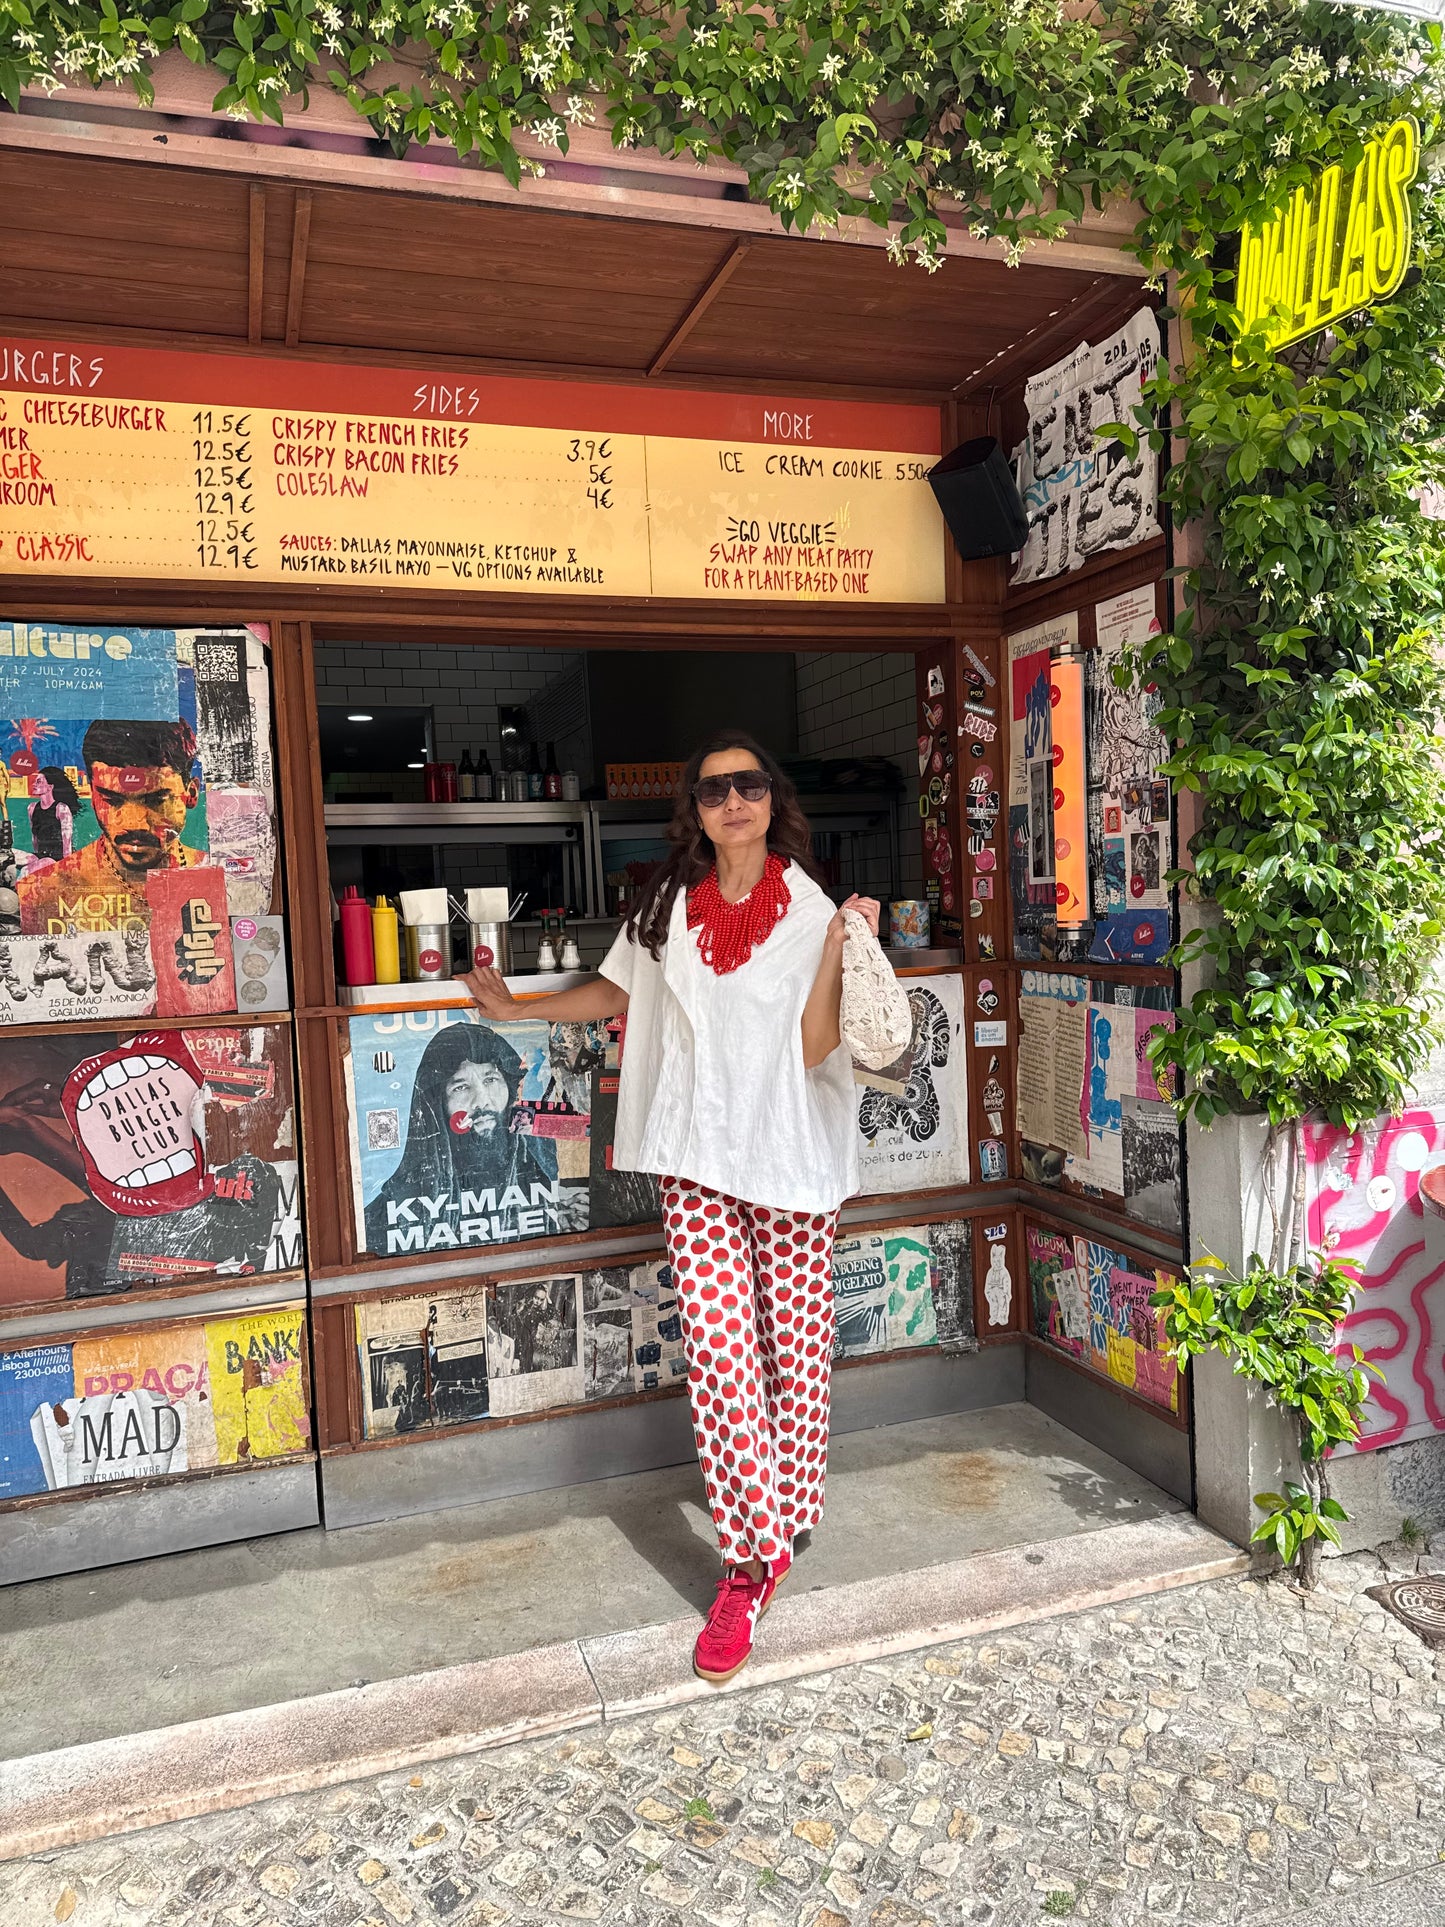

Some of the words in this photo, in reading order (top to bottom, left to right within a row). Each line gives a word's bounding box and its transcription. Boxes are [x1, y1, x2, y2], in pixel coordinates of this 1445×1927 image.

[413, 384, 480, 416] SIDES
[24, 399, 167, 432] CHEESEBURGER
[193, 411, 252, 437] 11.5€
[763, 410, 814, 440] MORE
[193, 440, 252, 462] 12.5€
[272, 416, 337, 441] CRISPY
[346, 421, 416, 446] FRENCH
[422, 426, 470, 449] FRIES
[567, 438, 612, 462] 3.9€
[0, 453, 43, 480] GER
[194, 466, 252, 490] 12.5€
[274, 443, 336, 468] CRISPY
[345, 449, 405, 473] BACON
[412, 453, 459, 476] FRIES
[589, 464, 613, 485] 5€
[719, 451, 744, 473] ICE
[765, 455, 824, 477] CREAM
[832, 460, 883, 480] COOKIE
[0, 481, 56, 506] ROOM
[195, 492, 255, 515] 12.9€
[276, 472, 369, 497] COLESLAW
[587, 488, 614, 509] 4€
[196, 519, 255, 543] 12.5€
[739, 520, 760, 543] GO
[768, 521, 824, 544] VEGGIE
[17, 534, 94, 562] CLASSIC
[197, 544, 258, 569] 12.9€
[279, 534, 337, 551] SAUCES:
[495, 544, 557, 562] KETCHUP
[567, 548, 578, 564] &
[709, 543, 757, 565] SWAP
[763, 545, 792, 566] ANY
[797, 547, 834, 568] MEAT
[837, 549, 873, 569] PATTY
[351, 558, 392, 575] BASIL
[396, 559, 431, 577] MAYO
[452, 562, 472, 579] VG
[477, 563, 532, 581] OPTIONS
[537, 565, 605, 584] AVAILABLE
[704, 568, 729, 589] FOR
[734, 570, 743, 590] A
[748, 570, 837, 593] PLANT-BASED
[842, 573, 870, 594] ONE
[14, 665, 27, 675] 12
[73, 667, 102, 678] 2024
[45, 679, 103, 690] 10PM/6AM
[58, 895, 135, 917] MOTEL
[48, 1007, 98, 1017] GAGLIANO
[99, 1077, 170, 1120] DALLAS
[109, 1101, 183, 1142] BURGER
[131, 1126, 179, 1159] CLUB
[898, 1151, 912, 1162] de
[387, 1181, 560, 1225] KY-MAN
[840, 1258, 880, 1274] BOEING
[842, 1272, 883, 1290] GELATO
[413, 1291, 438, 1299] LOCO
[240, 1320, 263, 1331] THE
[225, 1327, 300, 1374] BANK
[0, 1360, 30, 1372] isboa
[15, 1364, 70, 1380] 2300-0400
[80, 1405, 181, 1464] MAD
[133, 1465, 161, 1479] LIVRE
